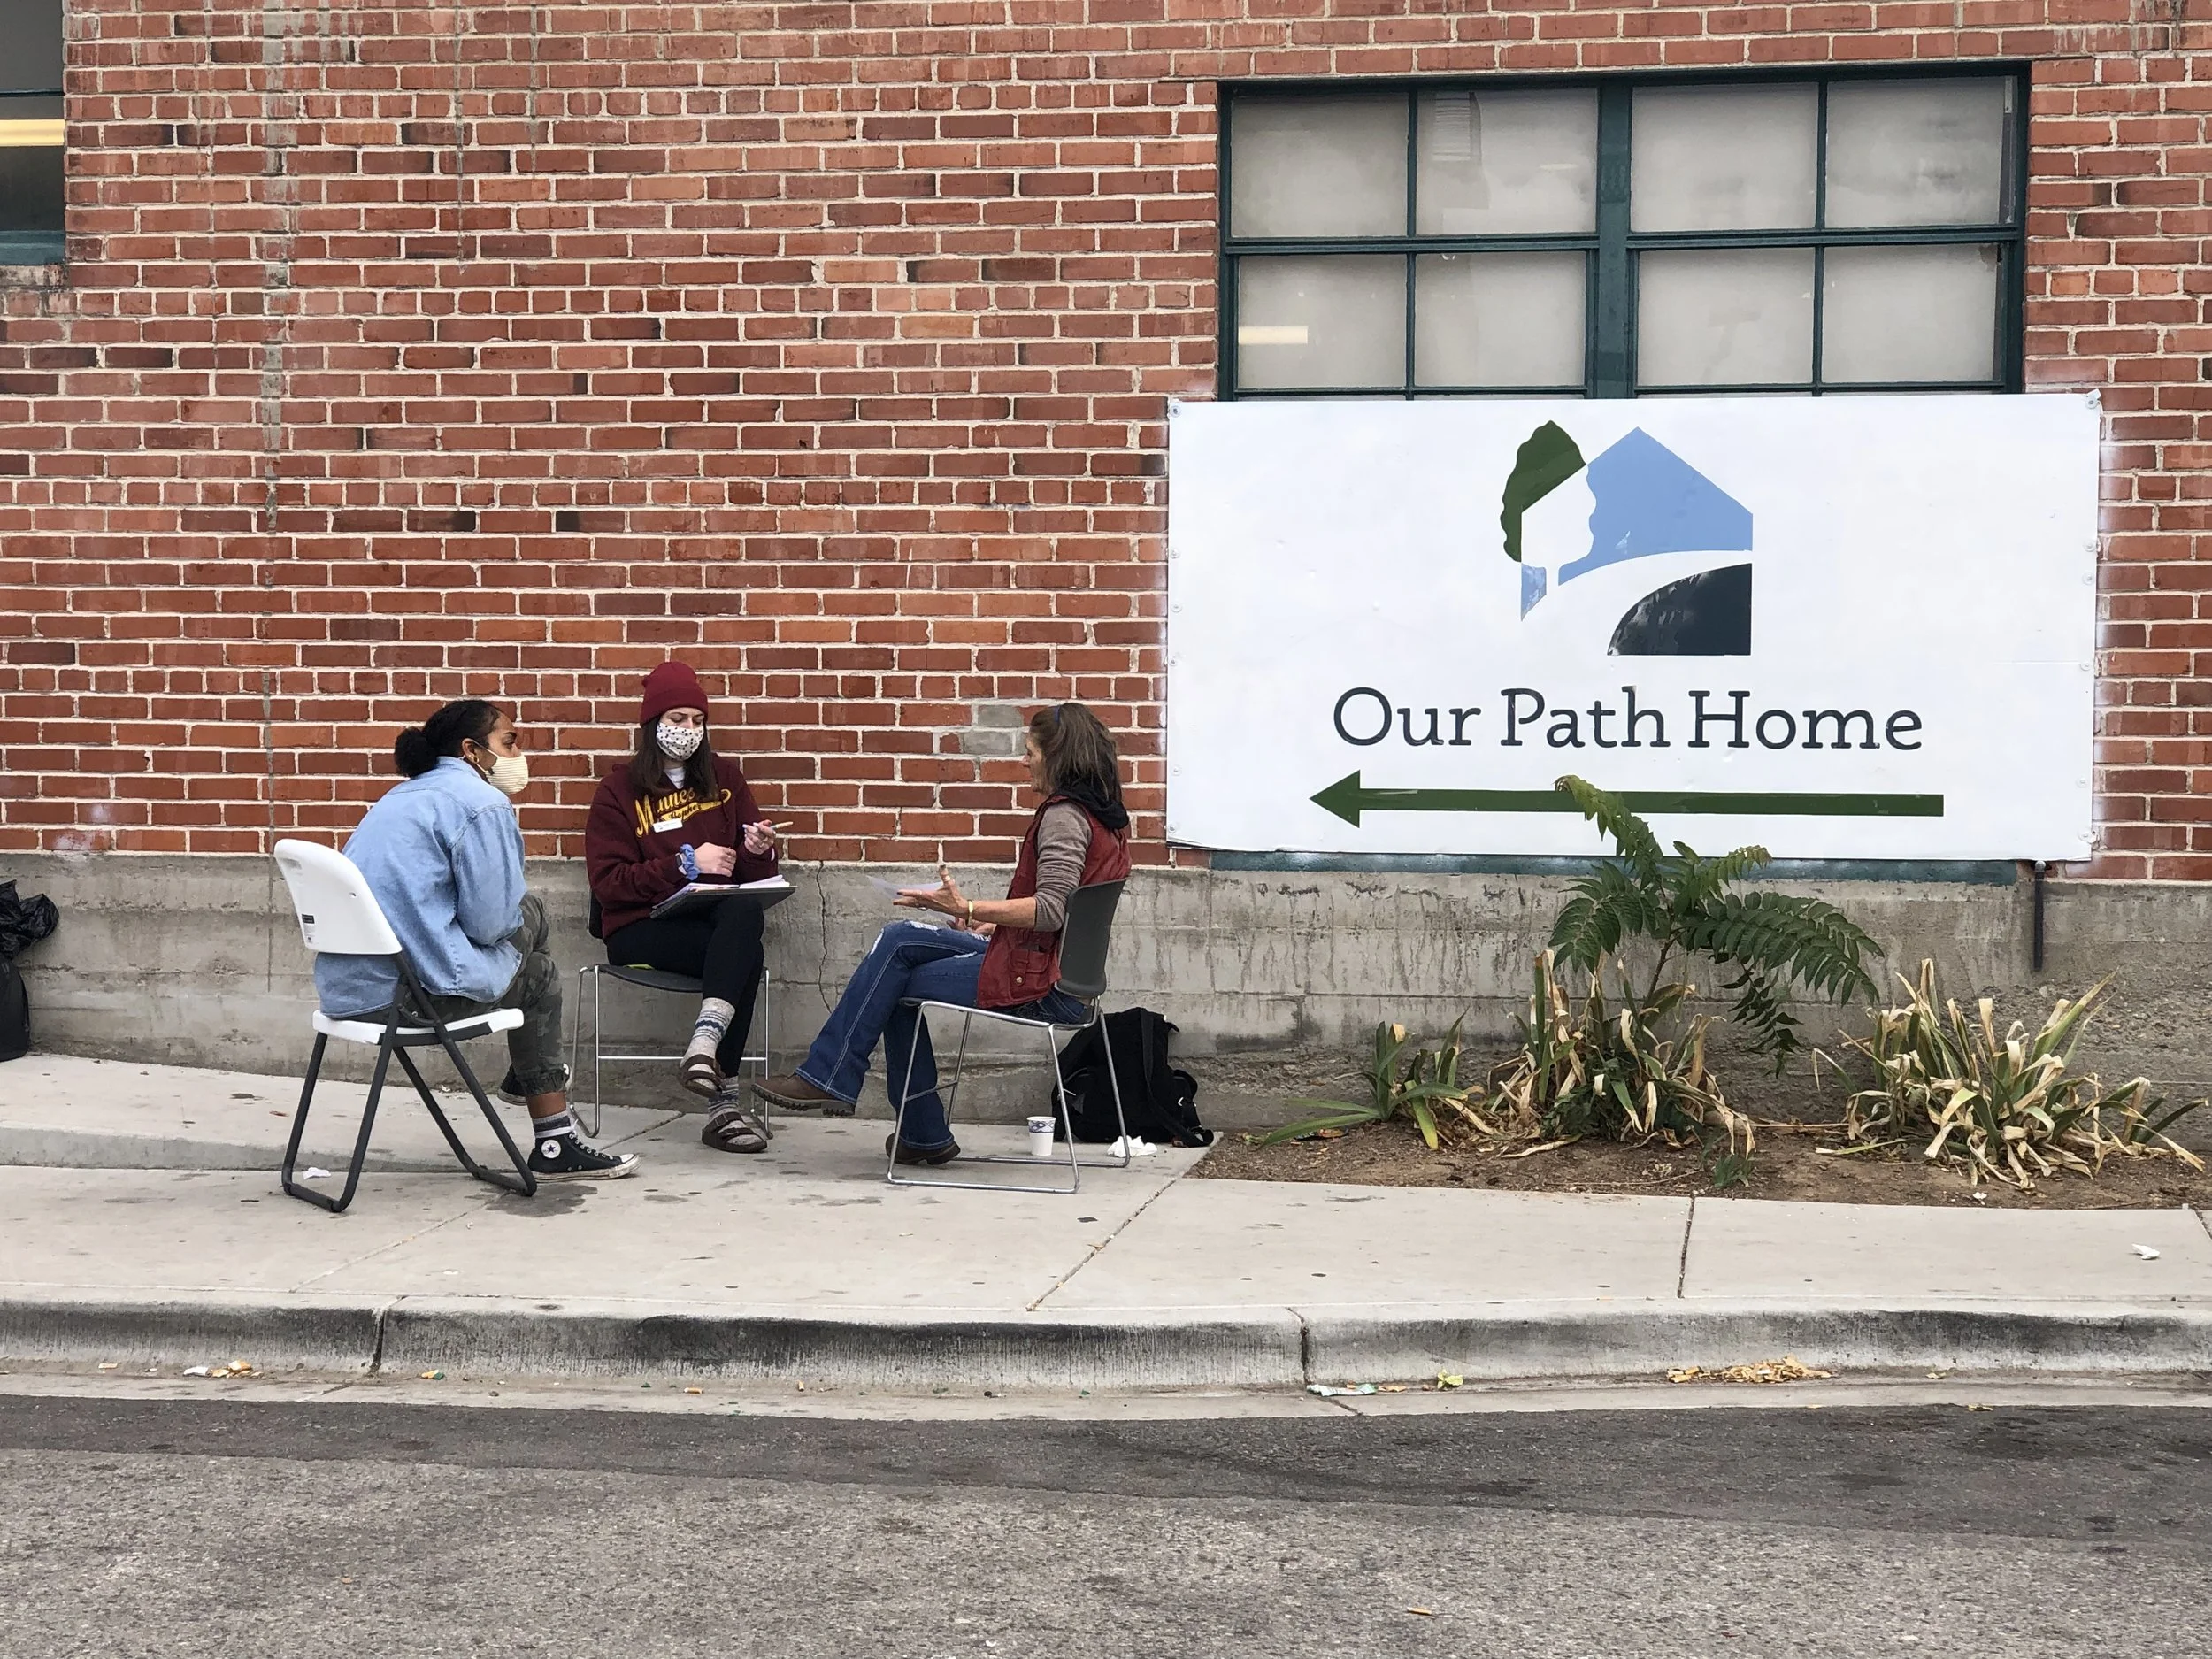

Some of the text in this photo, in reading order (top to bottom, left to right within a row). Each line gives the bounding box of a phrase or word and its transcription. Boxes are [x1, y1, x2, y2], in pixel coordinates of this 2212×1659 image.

[1333, 685, 1922, 751] Our Path Home
